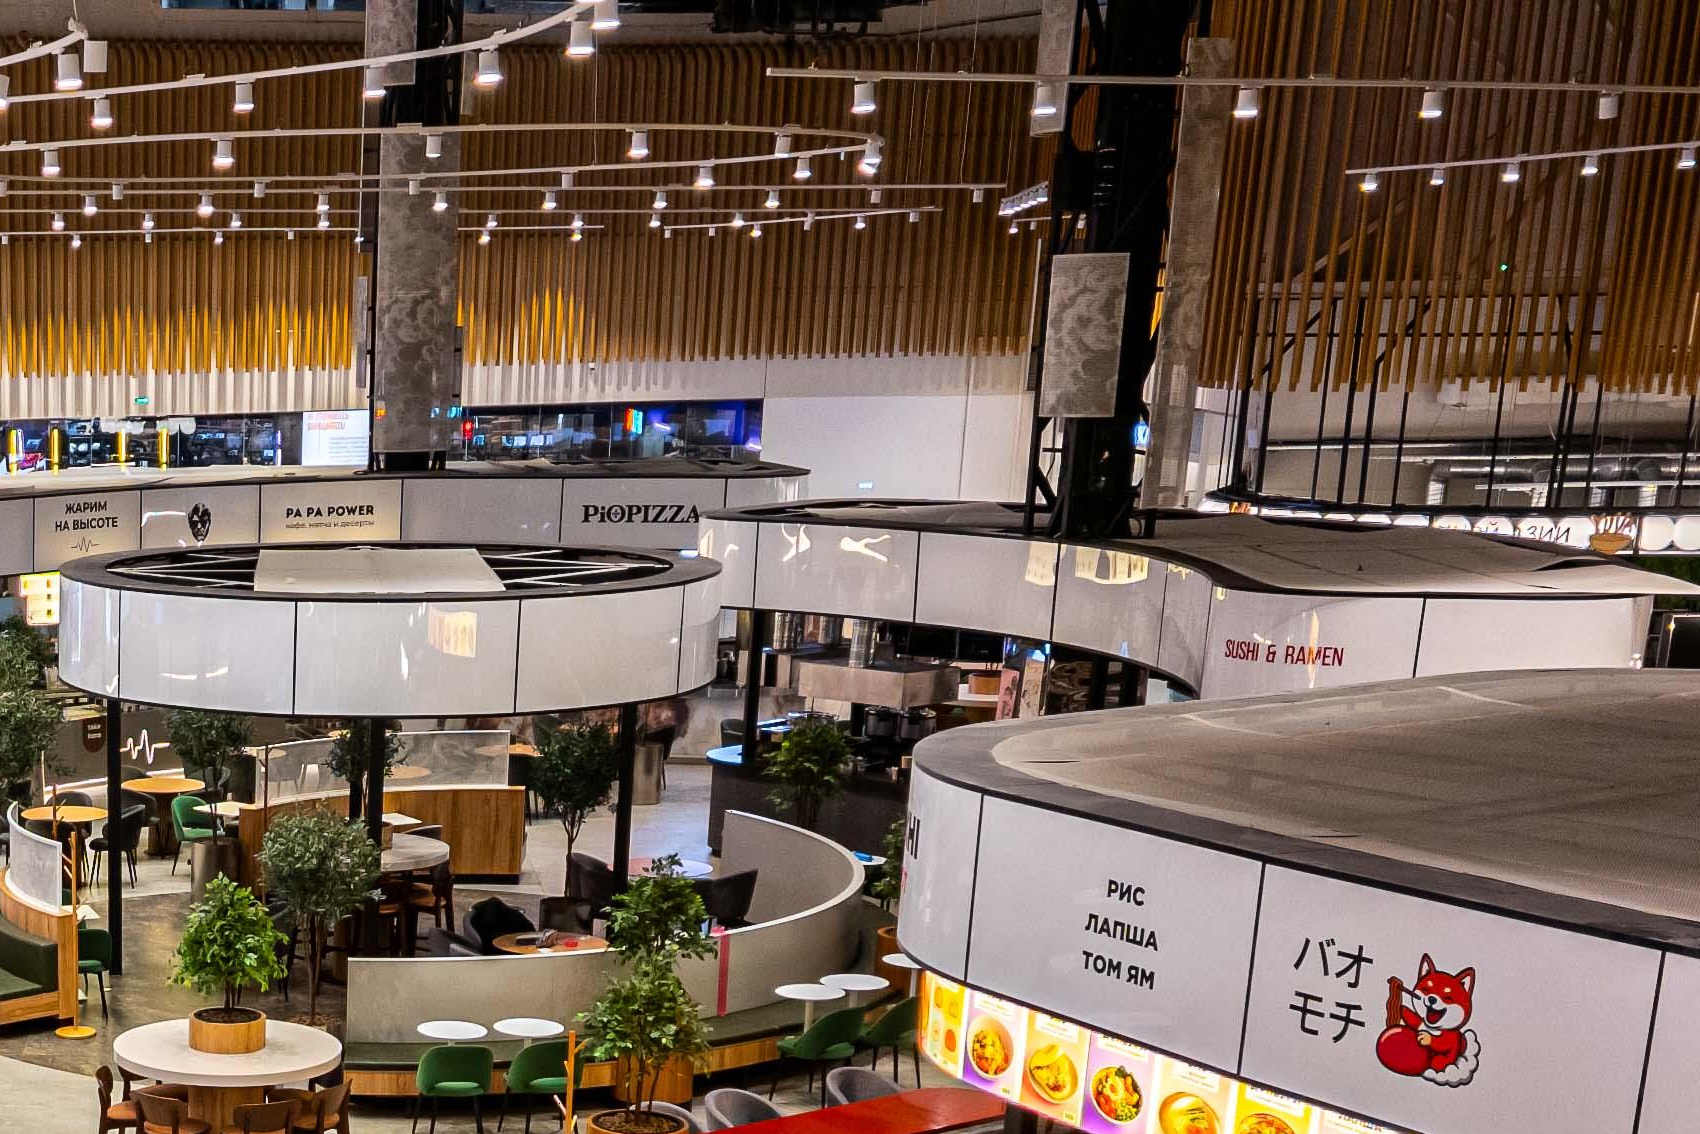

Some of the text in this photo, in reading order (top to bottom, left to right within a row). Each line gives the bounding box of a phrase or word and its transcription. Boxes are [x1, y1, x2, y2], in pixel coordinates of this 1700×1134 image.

[65, 500, 108, 515] ЖАРИМ
[286, 504, 375, 519] PA PA POWER
[55, 516, 119, 533] НА ВЫСОТЕ
[1225, 639, 1344, 667] SUSHI & RAMEN
[1107, 879, 1146, 907] РИС
[1084, 912, 1159, 952] ЛАПША
[1082, 949, 1156, 990] ТОМ ЯМ
[1293, 937, 1374, 989] バオ
[1288, 989, 1366, 1044] モチ
